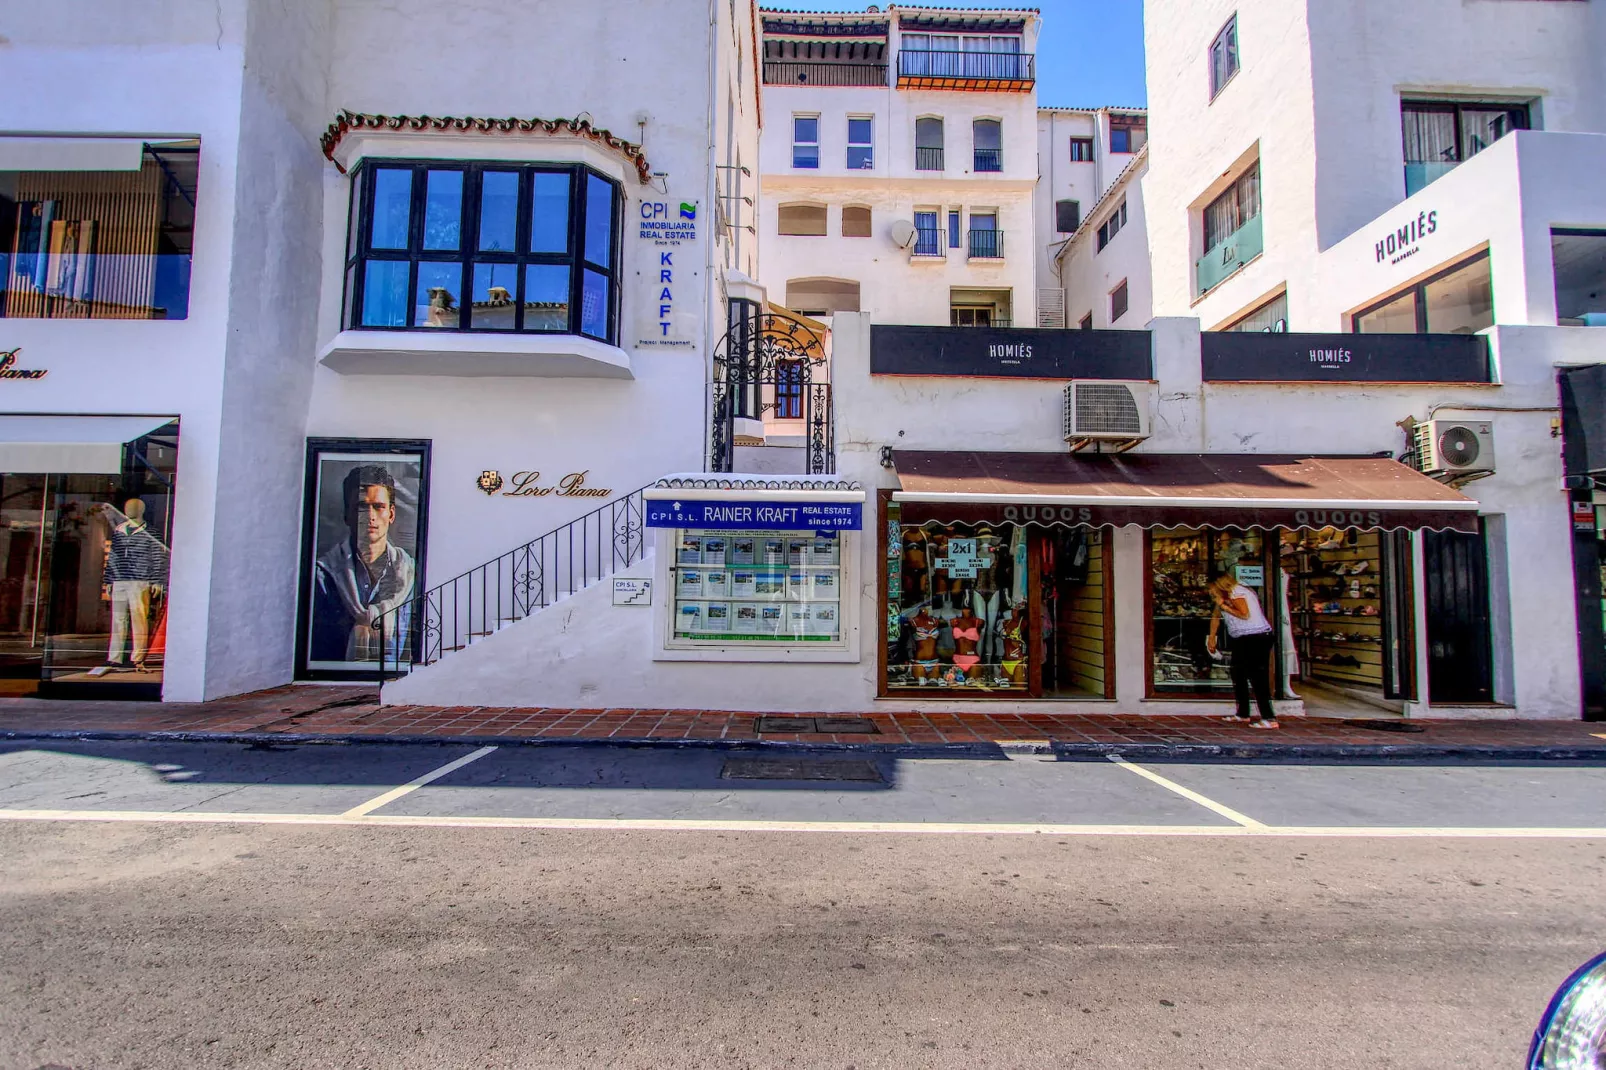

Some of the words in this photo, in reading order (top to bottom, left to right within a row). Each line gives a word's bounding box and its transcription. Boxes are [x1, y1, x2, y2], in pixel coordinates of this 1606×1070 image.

[641, 202, 667, 219] CPI
[640, 222, 695, 230] INMOBILIARIA
[640, 231, 662, 239] REAL
[665, 231, 696, 239] ESTATE
[1375, 210, 1437, 263] HOMIÉS
[659, 252, 673, 336] KRAFT
[990, 343, 1032, 358] HOMIÉS
[1309, 347, 1351, 363] HOMIÉS
[502, 471, 555, 497] Loro
[556, 470, 612, 497] Piana
[704, 506, 752, 522] RAINER
[756, 507, 798, 523] KRAFT
[802, 506, 822, 514] REAL
[824, 507, 851, 515] ESTATE
[1004, 506, 1092, 521] QUOOS
[1295, 510, 1380, 525] QUOOS
[808, 518, 831, 526] since
[832, 518, 852, 526] 1974
[952, 542, 971, 554] 2x1
